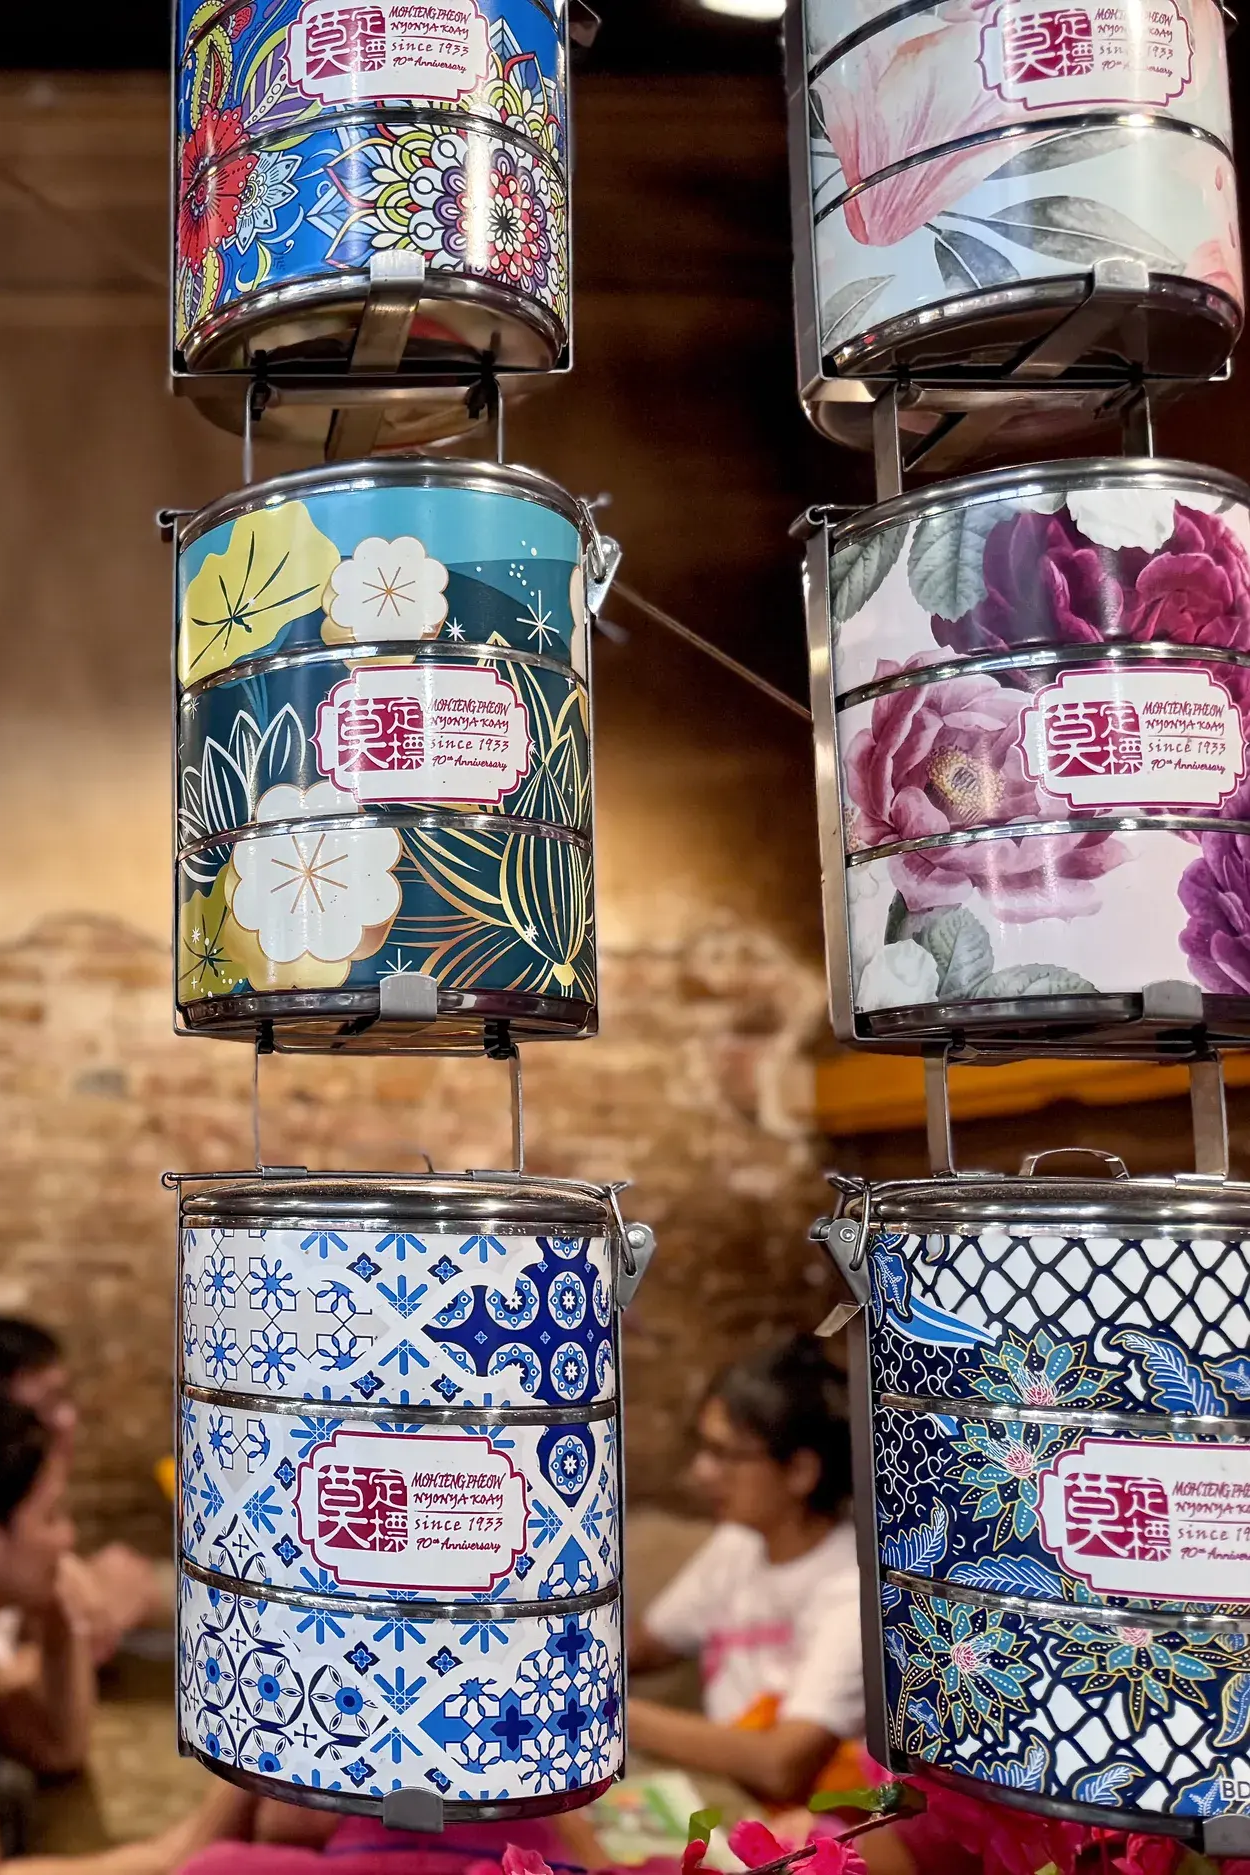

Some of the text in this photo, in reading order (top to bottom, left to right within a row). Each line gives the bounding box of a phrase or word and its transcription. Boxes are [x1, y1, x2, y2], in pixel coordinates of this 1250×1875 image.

[391, 22, 469, 40] NYONYA KOAY
[392, 39, 469, 56] since 1933
[414, 56, 466, 73] Anniversary
[480, 719, 509, 734] KOAY
[1146, 719, 1224, 736] NYONYA KOAY
[479, 738, 509, 752] 1933
[1149, 739, 1226, 755] since 1933
[454, 755, 507, 771] Anniversary
[1174, 759, 1225, 774] Anniversary
[413, 1492, 503, 1509] NYONYA KOAY
[1175, 1501, 1234, 1519] NYONYA
[414, 1515, 503, 1531] since 1933
[1178, 1525, 1228, 1540] since
[441, 1537, 501, 1553] Anniversary
